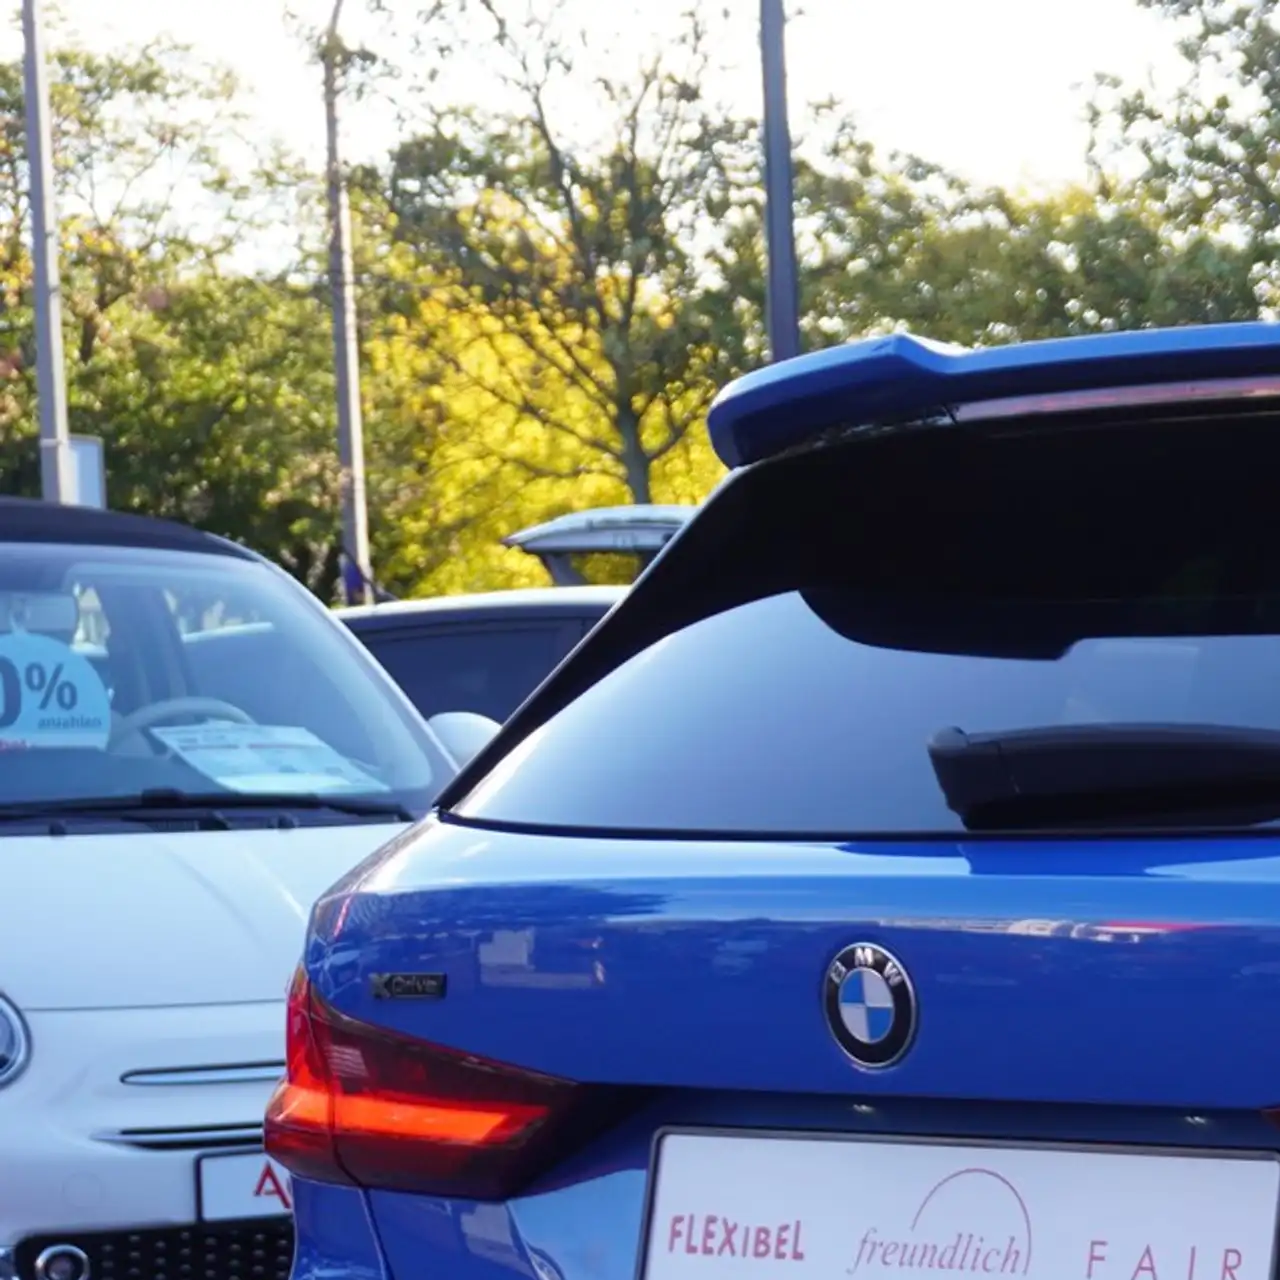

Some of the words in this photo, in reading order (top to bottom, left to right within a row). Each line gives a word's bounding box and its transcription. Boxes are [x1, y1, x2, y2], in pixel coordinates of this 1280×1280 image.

[830, 947, 903, 987] BMW
[668, 1213, 805, 1261] FLEXIBEL
[845, 1227, 1021, 1275] freundlich
